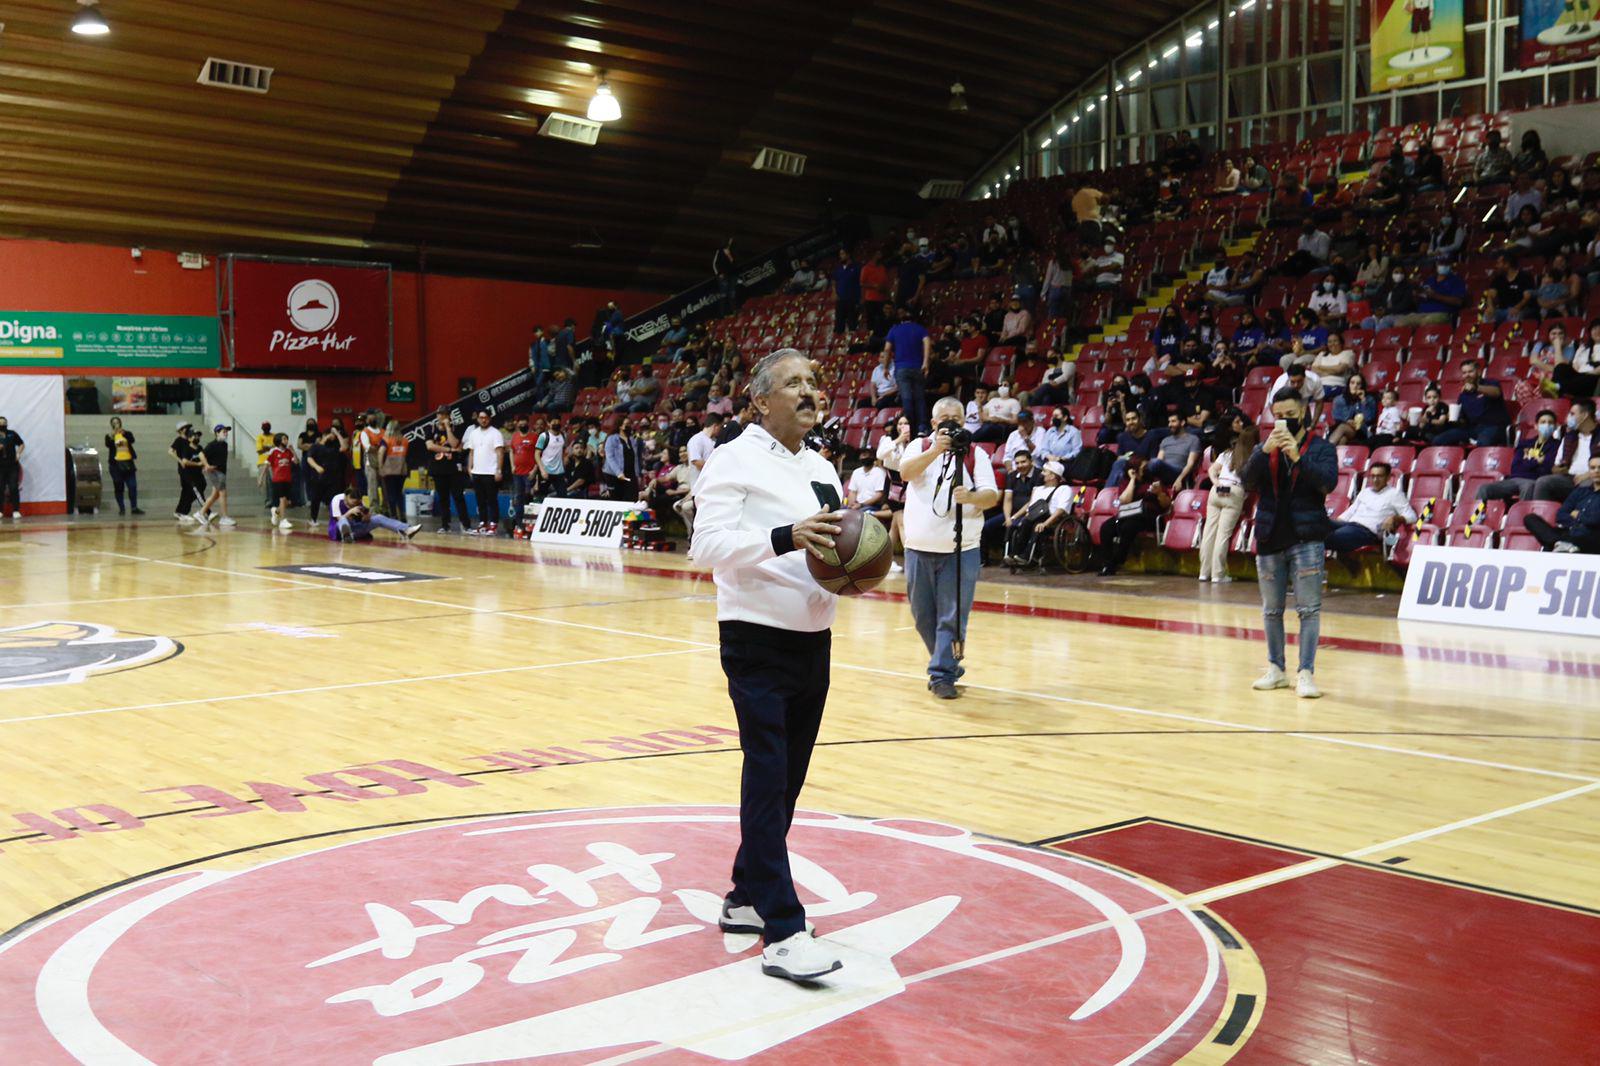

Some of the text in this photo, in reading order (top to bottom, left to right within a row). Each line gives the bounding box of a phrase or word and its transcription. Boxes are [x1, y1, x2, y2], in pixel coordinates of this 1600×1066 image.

[0, 319, 57, 344] Digna
[269, 329, 357, 352] Pizza Hut
[1416, 560, 1600, 619] DROP-SH
[140, 758, 486, 819] LOVE
[10, 803, 146, 845] OF
[305, 841, 676, 968] Hut
